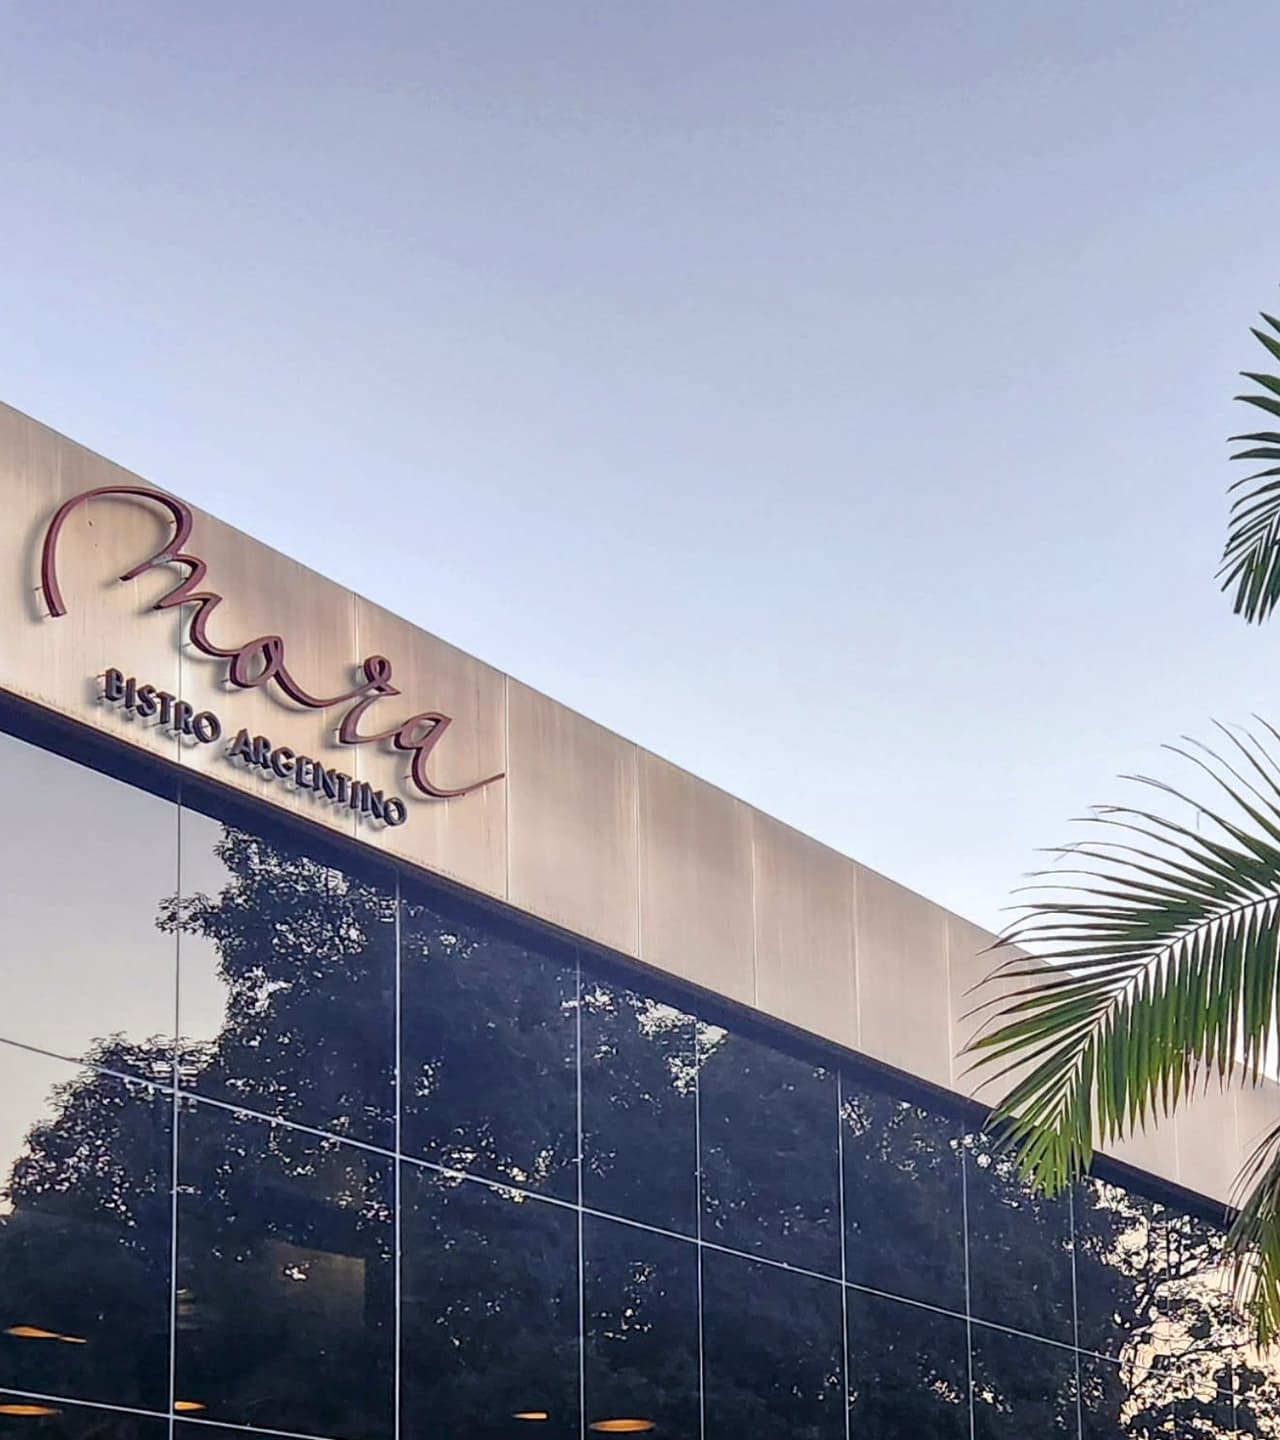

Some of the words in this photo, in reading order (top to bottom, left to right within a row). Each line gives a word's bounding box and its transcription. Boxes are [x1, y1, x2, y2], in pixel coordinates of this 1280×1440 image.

[40, 485, 506, 800] Mara
[104, 667, 222, 744] BISTRO
[228, 728, 408, 827] ARGENTINO
